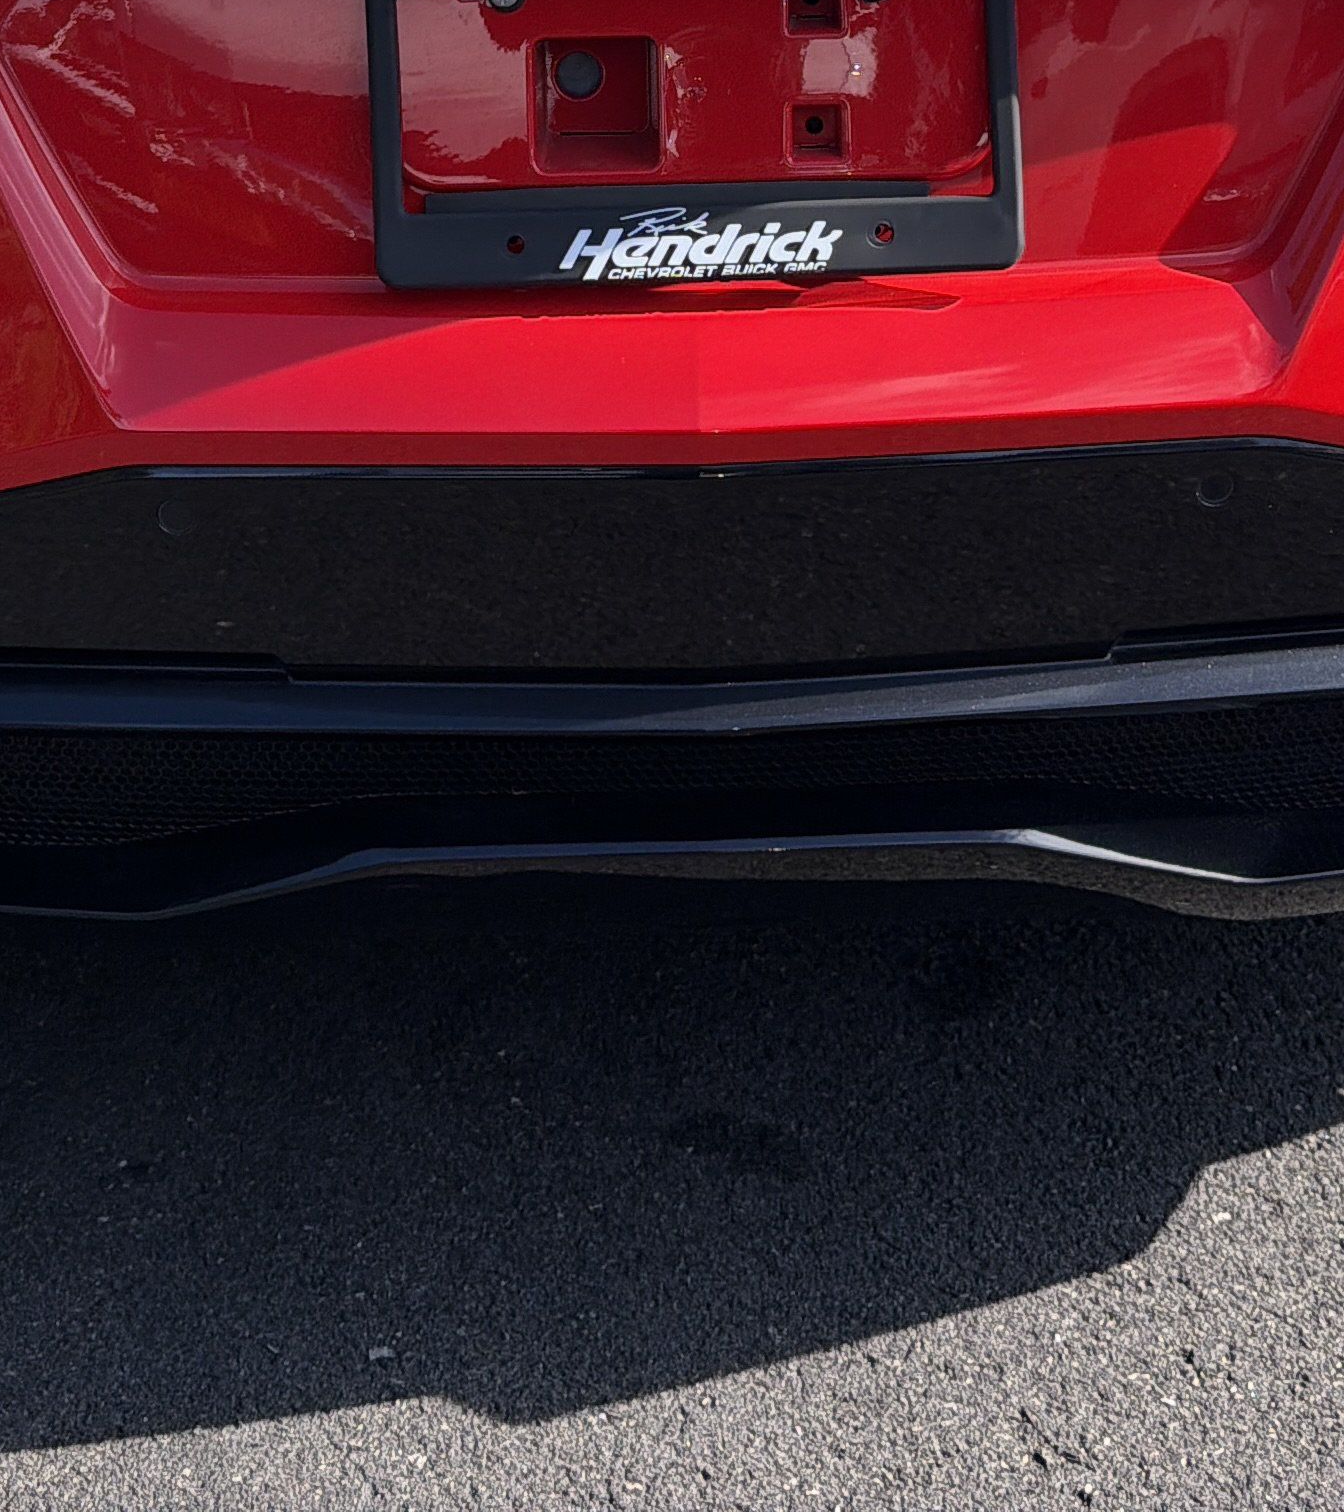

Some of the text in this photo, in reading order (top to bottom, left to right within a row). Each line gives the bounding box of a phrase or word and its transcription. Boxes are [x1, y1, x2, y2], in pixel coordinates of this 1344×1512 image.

[559, 220, 843, 281] Hendrick
[607, 265, 719, 281] CHEVROLET
[721, 262, 777, 276] BUICK
